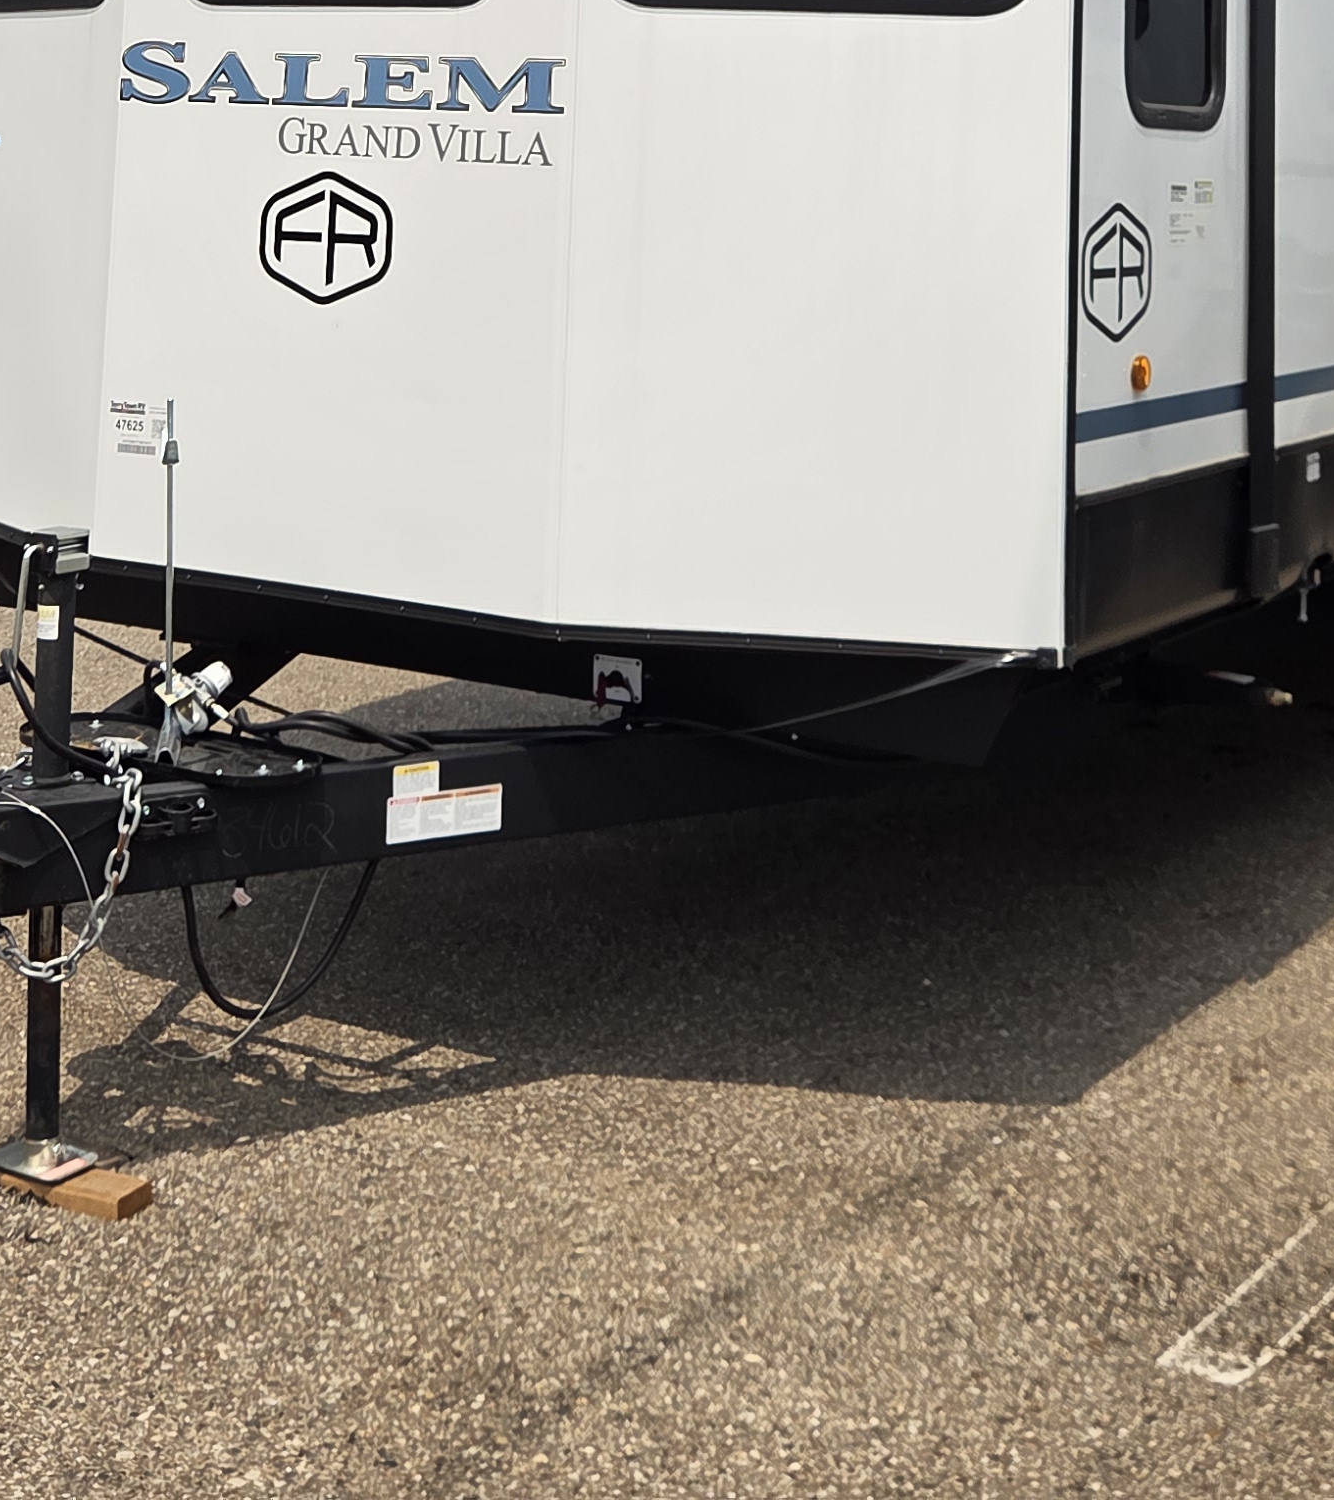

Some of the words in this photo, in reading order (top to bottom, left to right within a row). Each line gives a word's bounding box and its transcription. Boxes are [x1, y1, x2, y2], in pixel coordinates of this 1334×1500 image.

[119, 40, 567, 115] SALEM
[278, 116, 422, 160] GRAND
[427, 122, 554, 167] VILLA
[115, 418, 145, 432] 47625
